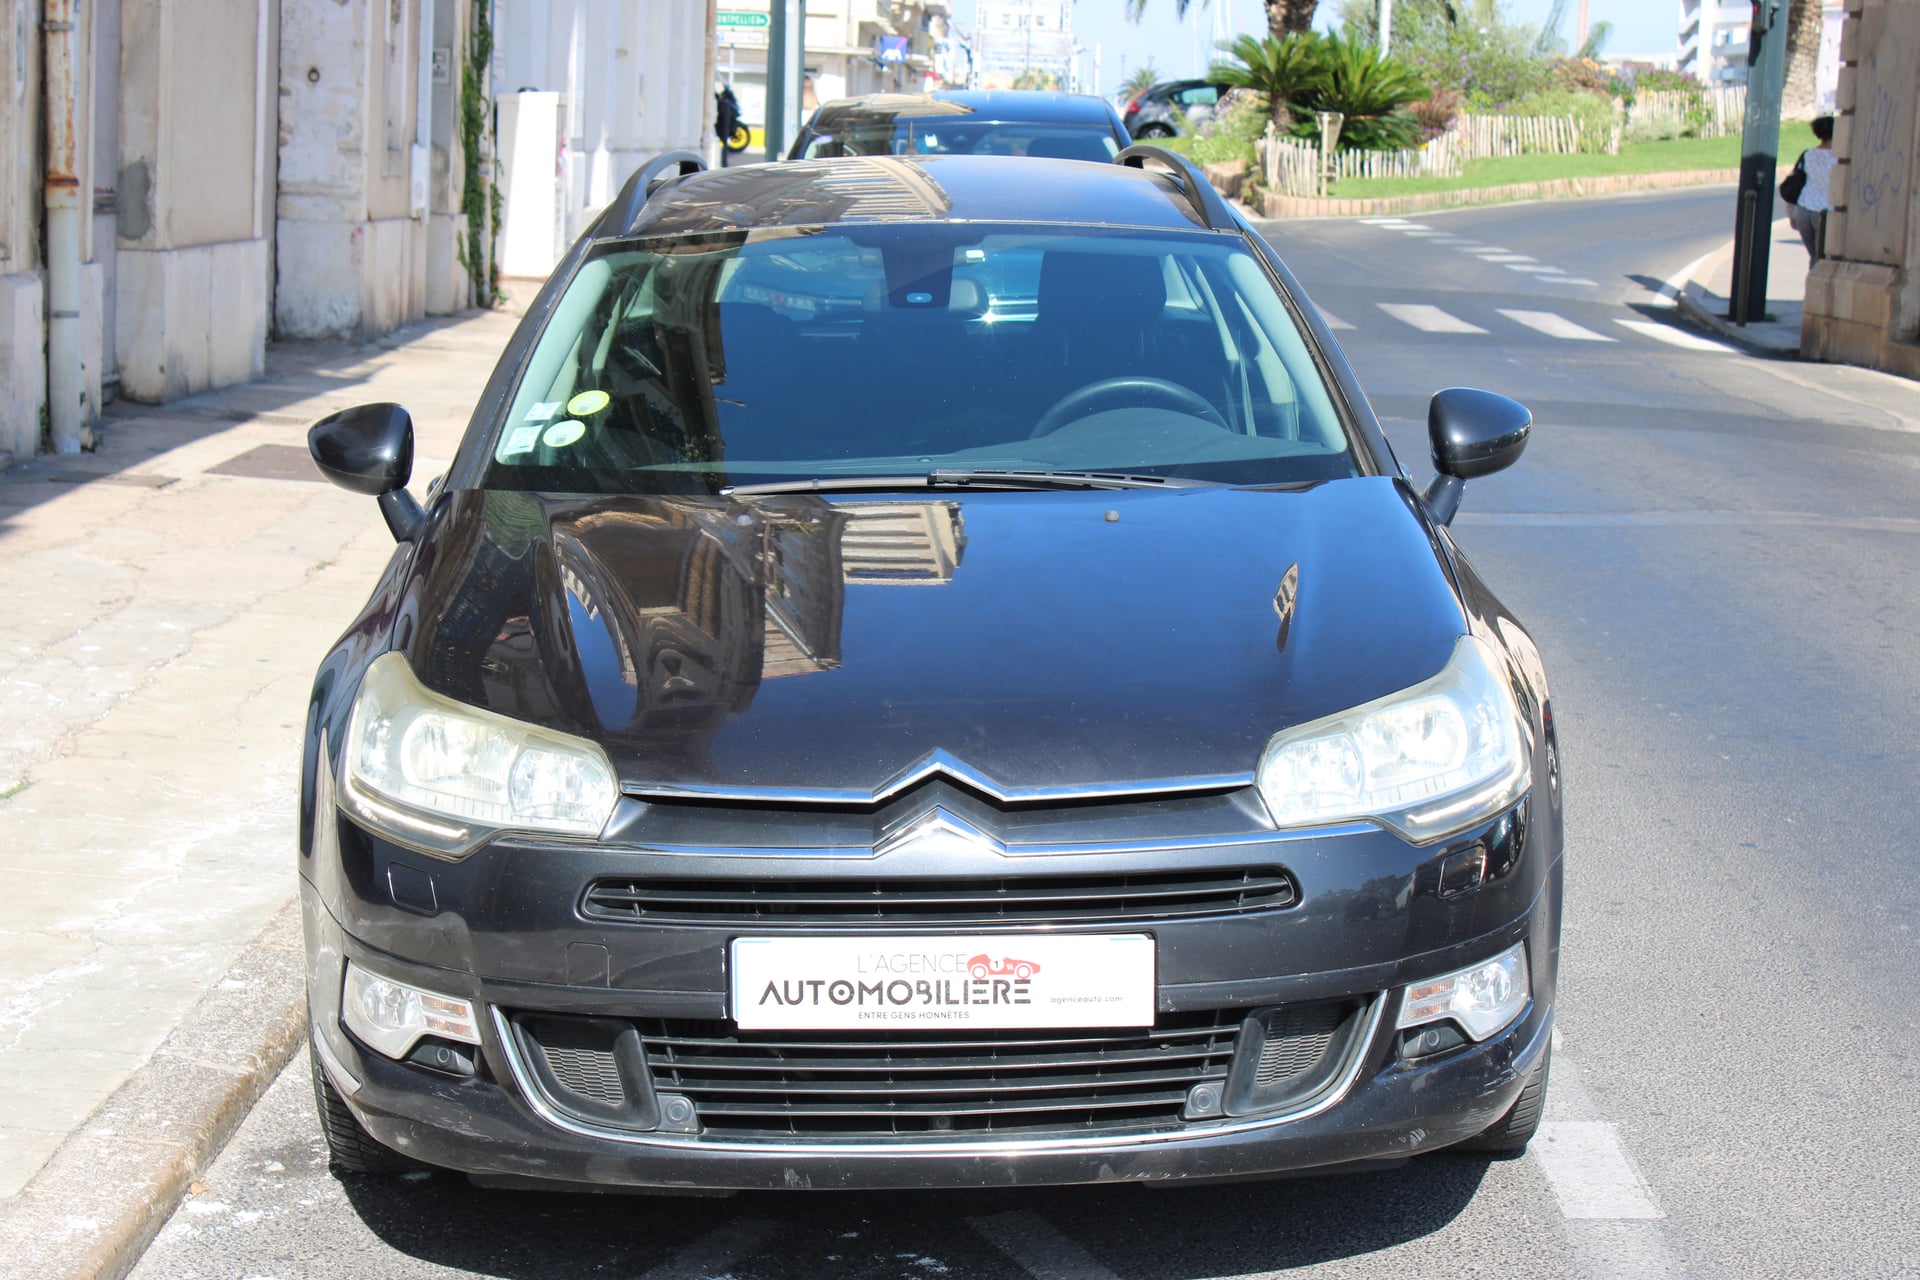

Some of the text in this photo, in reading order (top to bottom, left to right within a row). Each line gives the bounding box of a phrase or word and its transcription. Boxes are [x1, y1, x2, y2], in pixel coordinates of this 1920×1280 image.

[881, 48, 902, 61] AXA
[858, 954, 968, 973] L'AGENCE
[1051, 996, 1123, 1004] agenceauto.com
[858, 1011, 888, 1020] ENTRE
[891, 1011, 917, 1020] GENS
